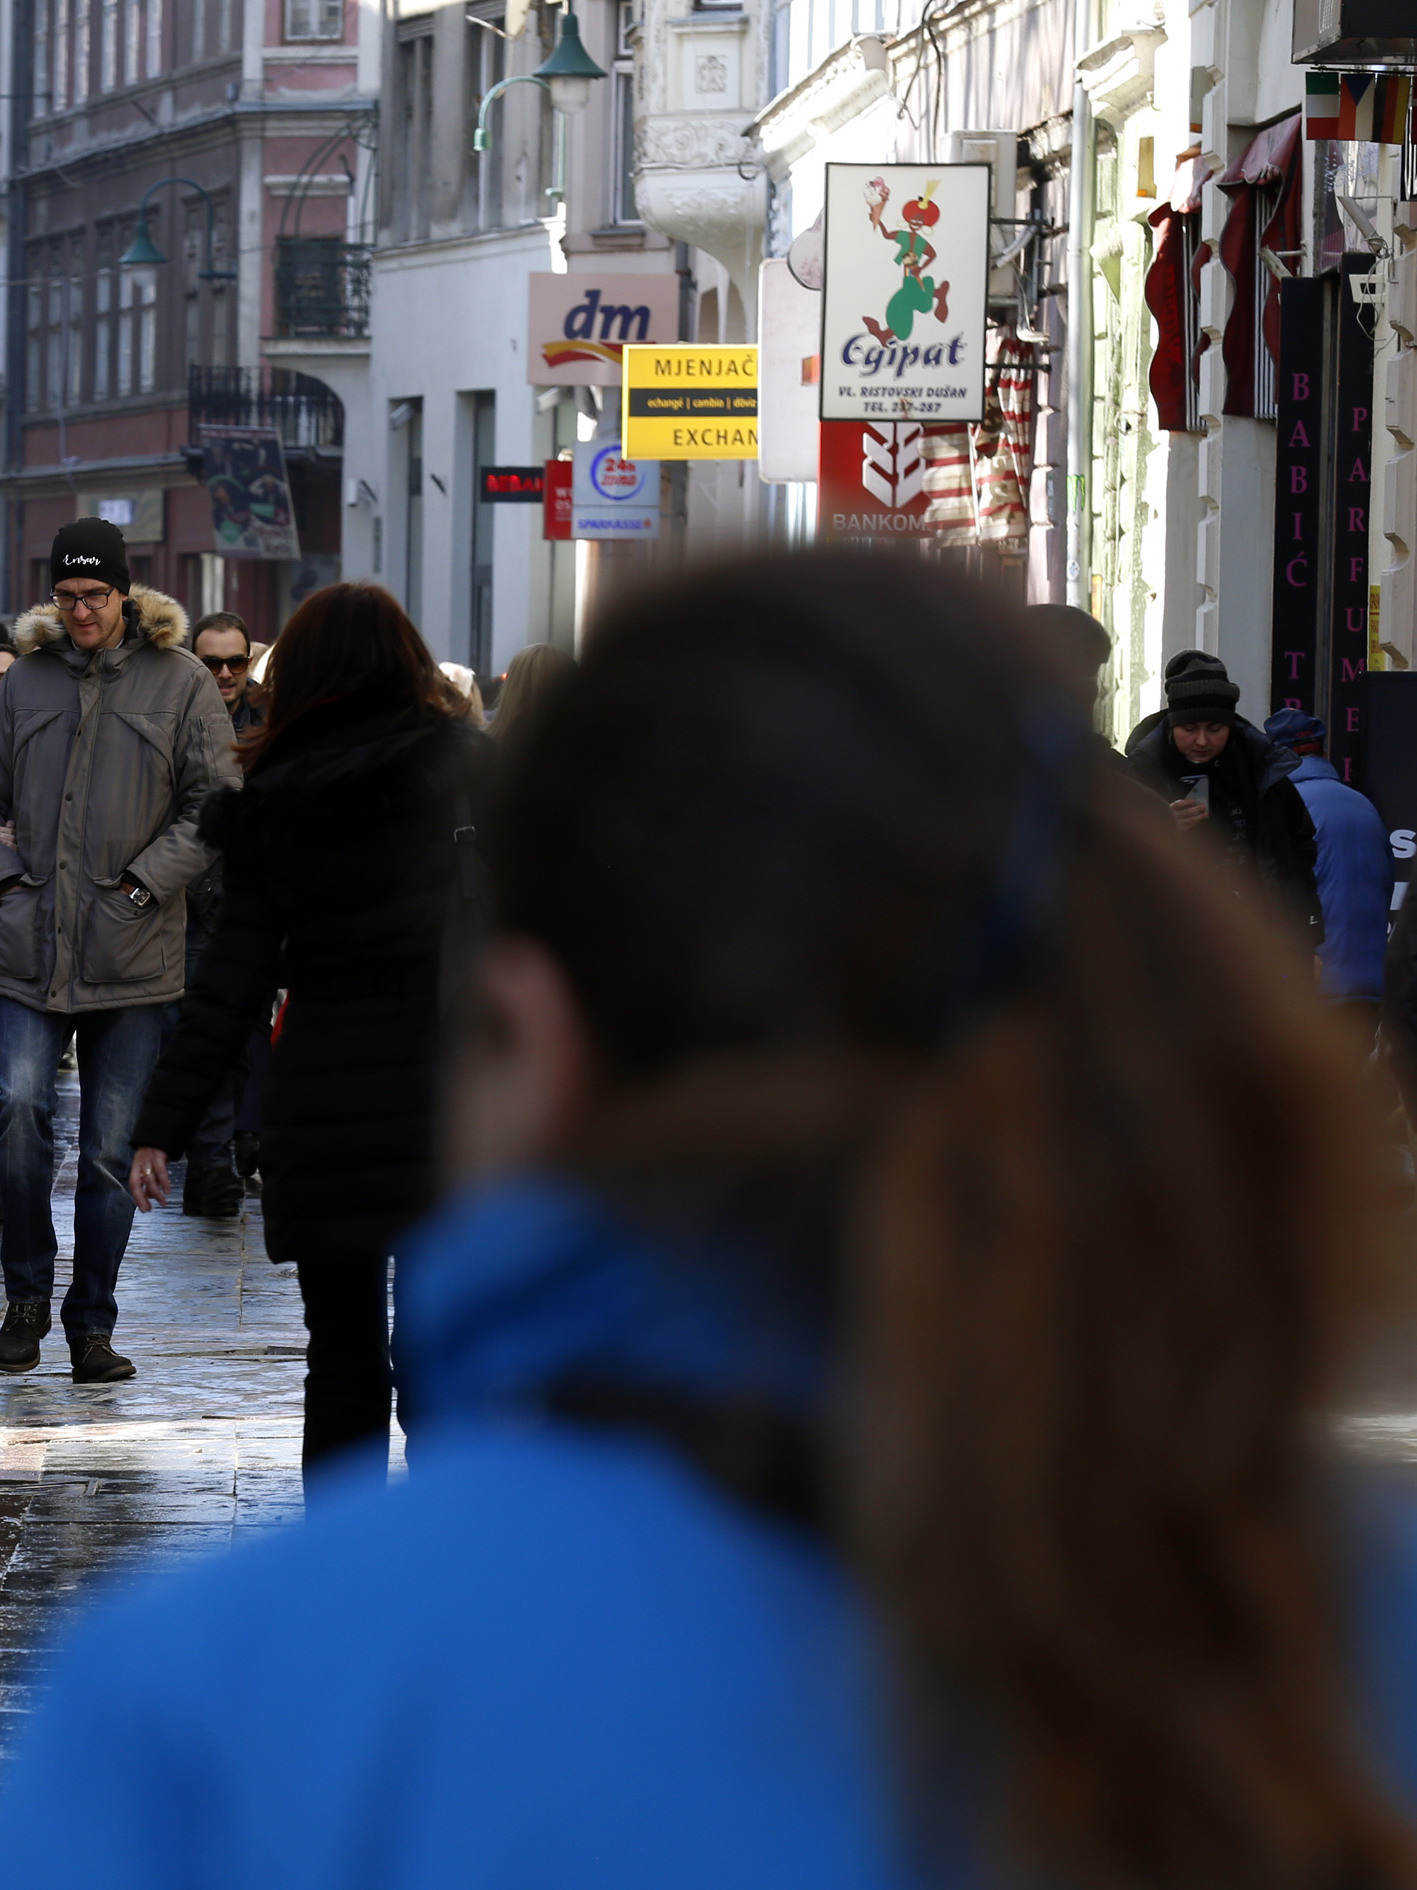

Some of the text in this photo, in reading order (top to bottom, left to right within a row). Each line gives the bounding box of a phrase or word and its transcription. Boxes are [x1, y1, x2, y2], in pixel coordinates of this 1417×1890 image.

[564, 289, 650, 340] dm
[655, 354, 758, 376] MJENJAČ
[841, 331, 966, 379] Egipat
[860, 387, 923, 398] RISTOVSKI
[926, 385, 967, 398] DUŠAN
[864, 402, 888, 412] TEL.
[1286, 372, 1310, 588] BABIĆ
[832, 513, 932, 532] BANKOM
